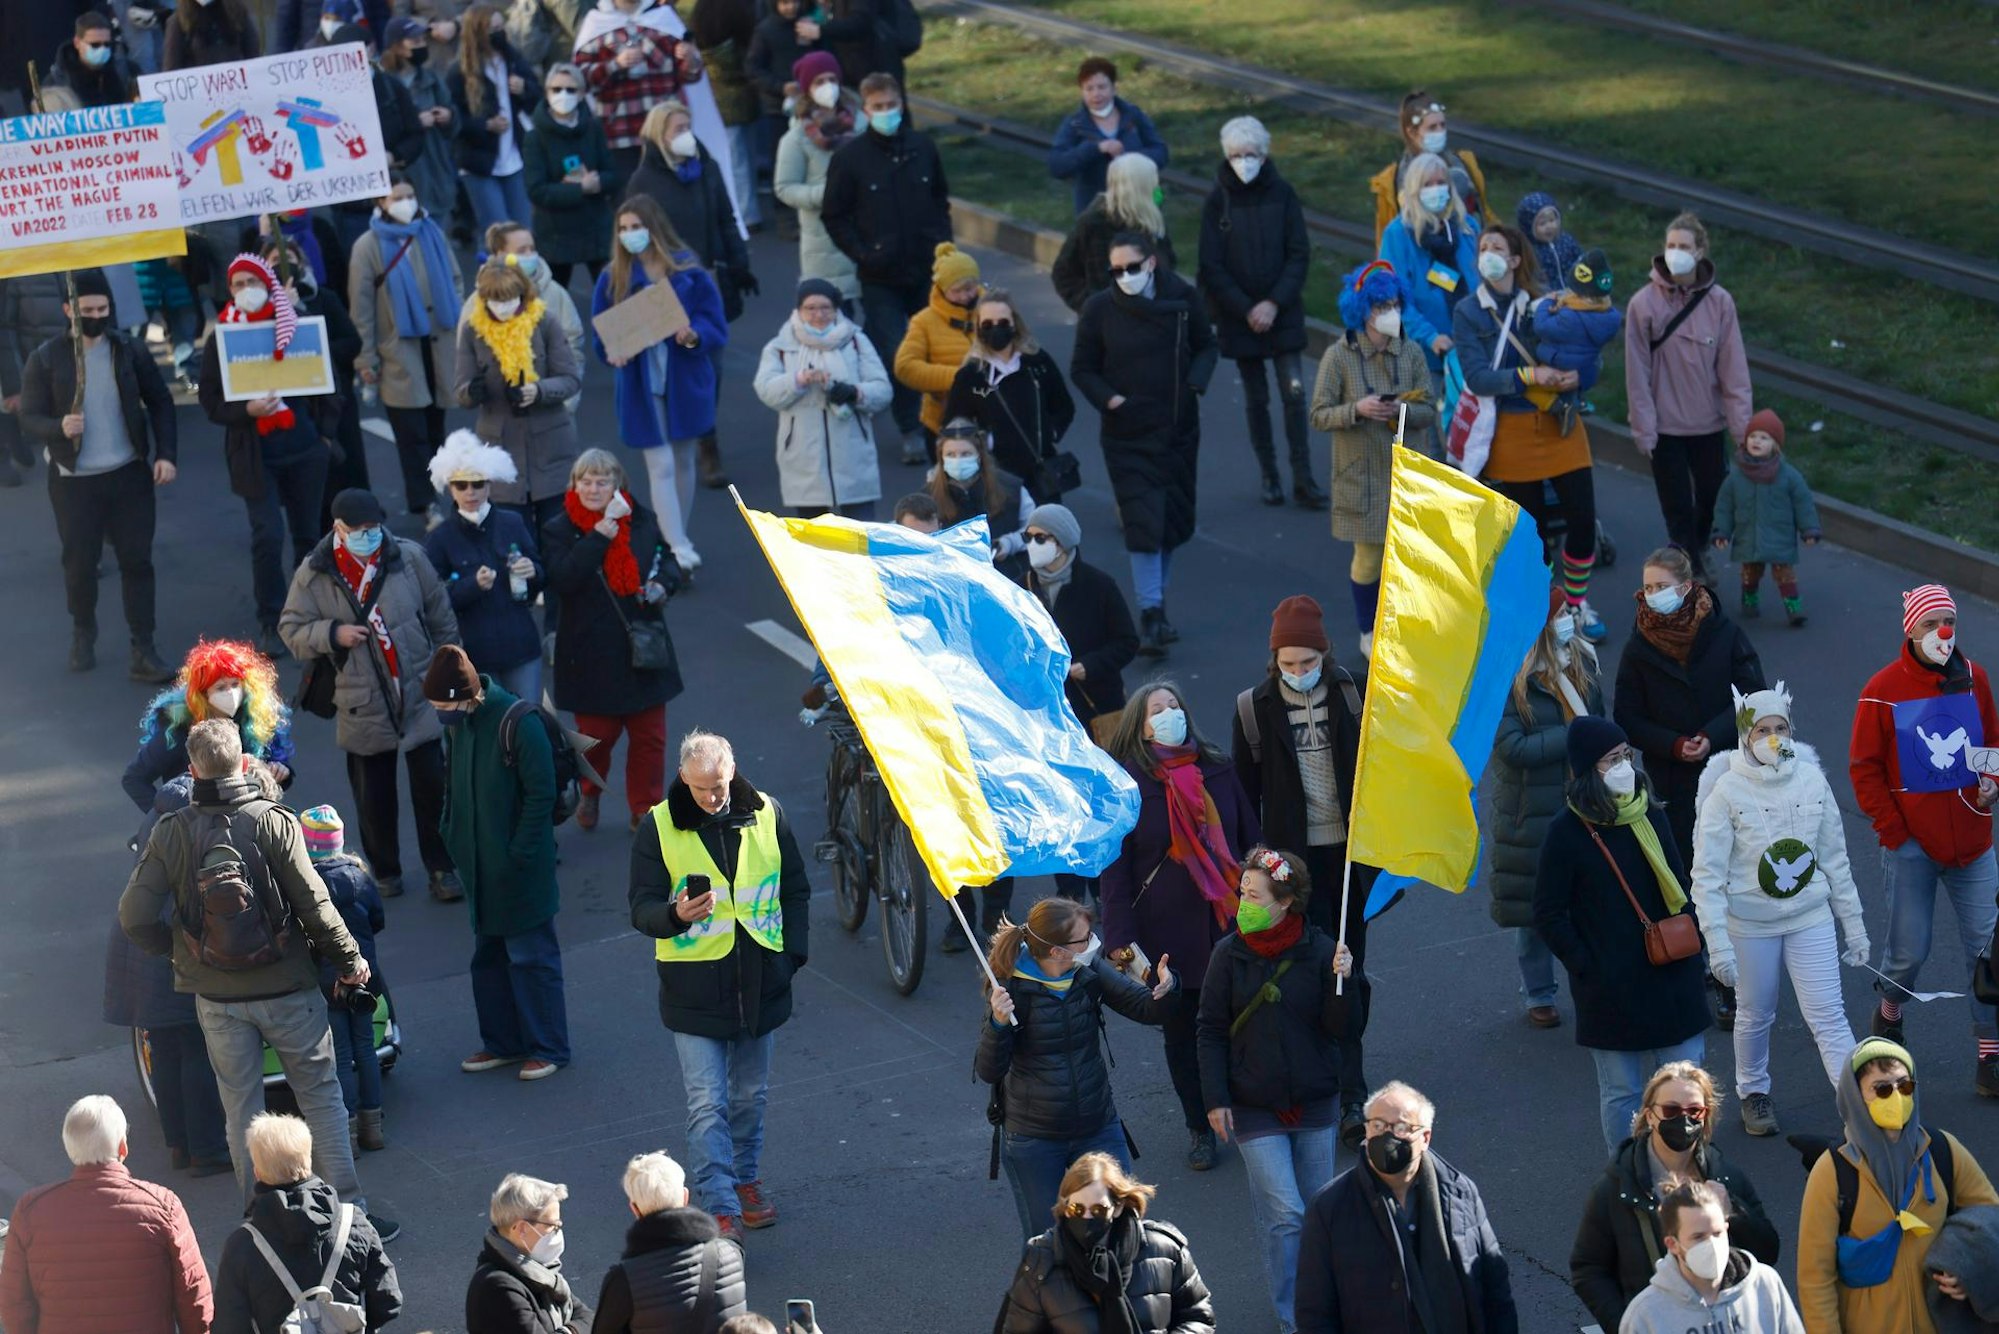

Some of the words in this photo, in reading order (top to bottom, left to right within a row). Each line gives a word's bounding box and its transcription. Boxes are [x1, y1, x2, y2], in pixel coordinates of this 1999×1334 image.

[155, 76, 198, 103] STOP
[203, 68, 248, 95] WAR!
[268, 59, 308, 86] STOP
[313, 50, 366, 77] PUTIN!
[0, 118, 16, 141] E
[23, 111, 68, 138] WAY
[71, 104, 135, 133] TICKET
[31, 136, 109, 156] VLADIMIR
[113, 128, 160, 144] PUTIN
[70, 150, 140, 171] MOSCOW
[106, 165, 173, 185] CRIMINAL
[35, 196, 64, 211] THE
[71, 187, 122, 207] HAGUE
[180, 194, 235, 218] ELFEN
[244, 187, 278, 206] WIR
[287, 182, 317, 204] DER
[323, 170, 388, 197] UKRAINE!
[106, 207, 133, 224] FEB
[138, 203, 158, 219] 28
